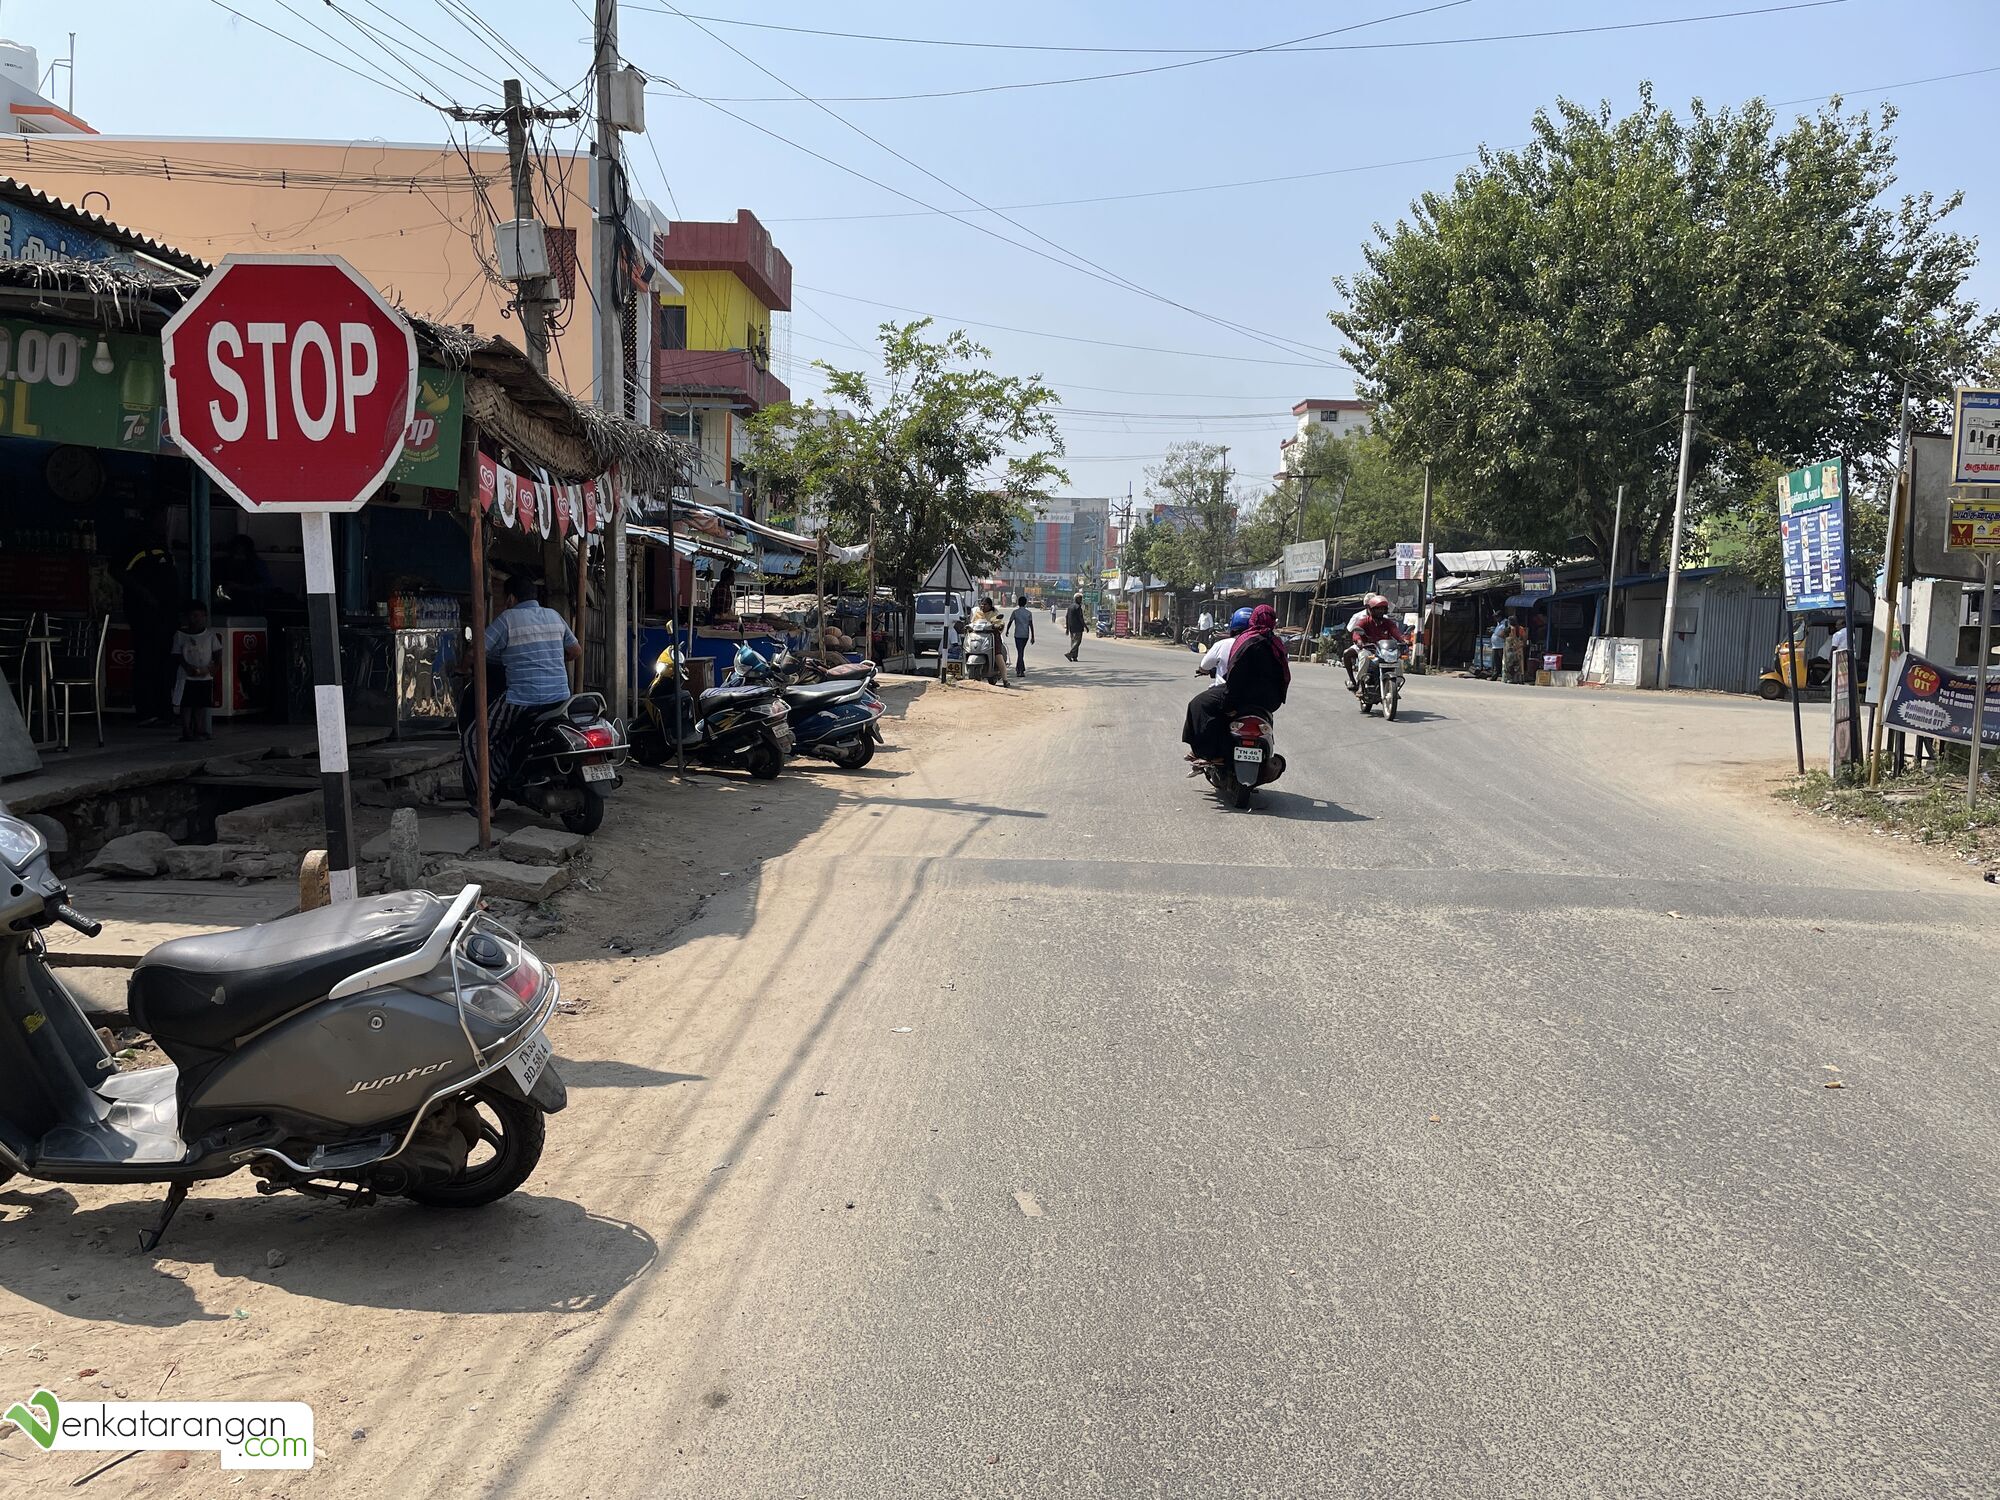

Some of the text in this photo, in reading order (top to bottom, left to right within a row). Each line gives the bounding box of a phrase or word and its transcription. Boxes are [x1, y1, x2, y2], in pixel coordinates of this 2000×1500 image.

[207, 320, 379, 442] STOP
[1914, 667, 1936, 680] Free
[1914, 679, 1930, 691] OTT
[1905, 702, 1933, 716] Unlimited
[1904, 711, 1932, 724] Unlimited
[346, 1059, 453, 1095] Jupiter
